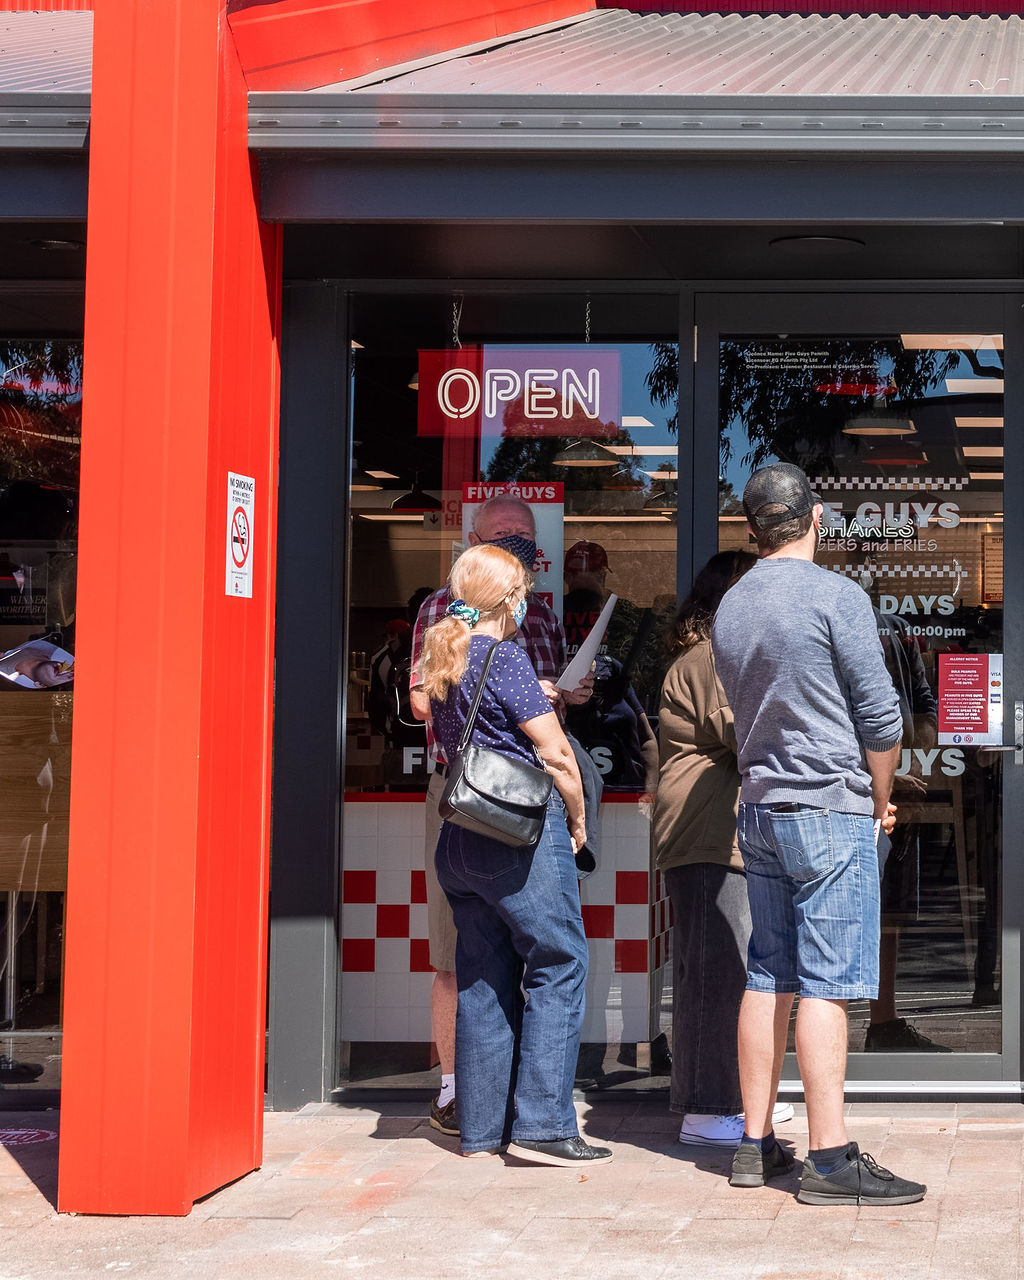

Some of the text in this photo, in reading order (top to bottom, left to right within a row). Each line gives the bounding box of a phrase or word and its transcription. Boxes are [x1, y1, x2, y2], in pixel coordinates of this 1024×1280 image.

[438, 368, 599, 419] OPEN
[467, 487, 556, 499] FIVE GUYS
[856, 502, 960, 528] GUYS
[818, 539, 938, 552] GERS and FRIES
[880, 595, 955, 615] DAYS
[905, 626, 966, 638] 10:00pm
[894, 748, 966, 777] UYS
